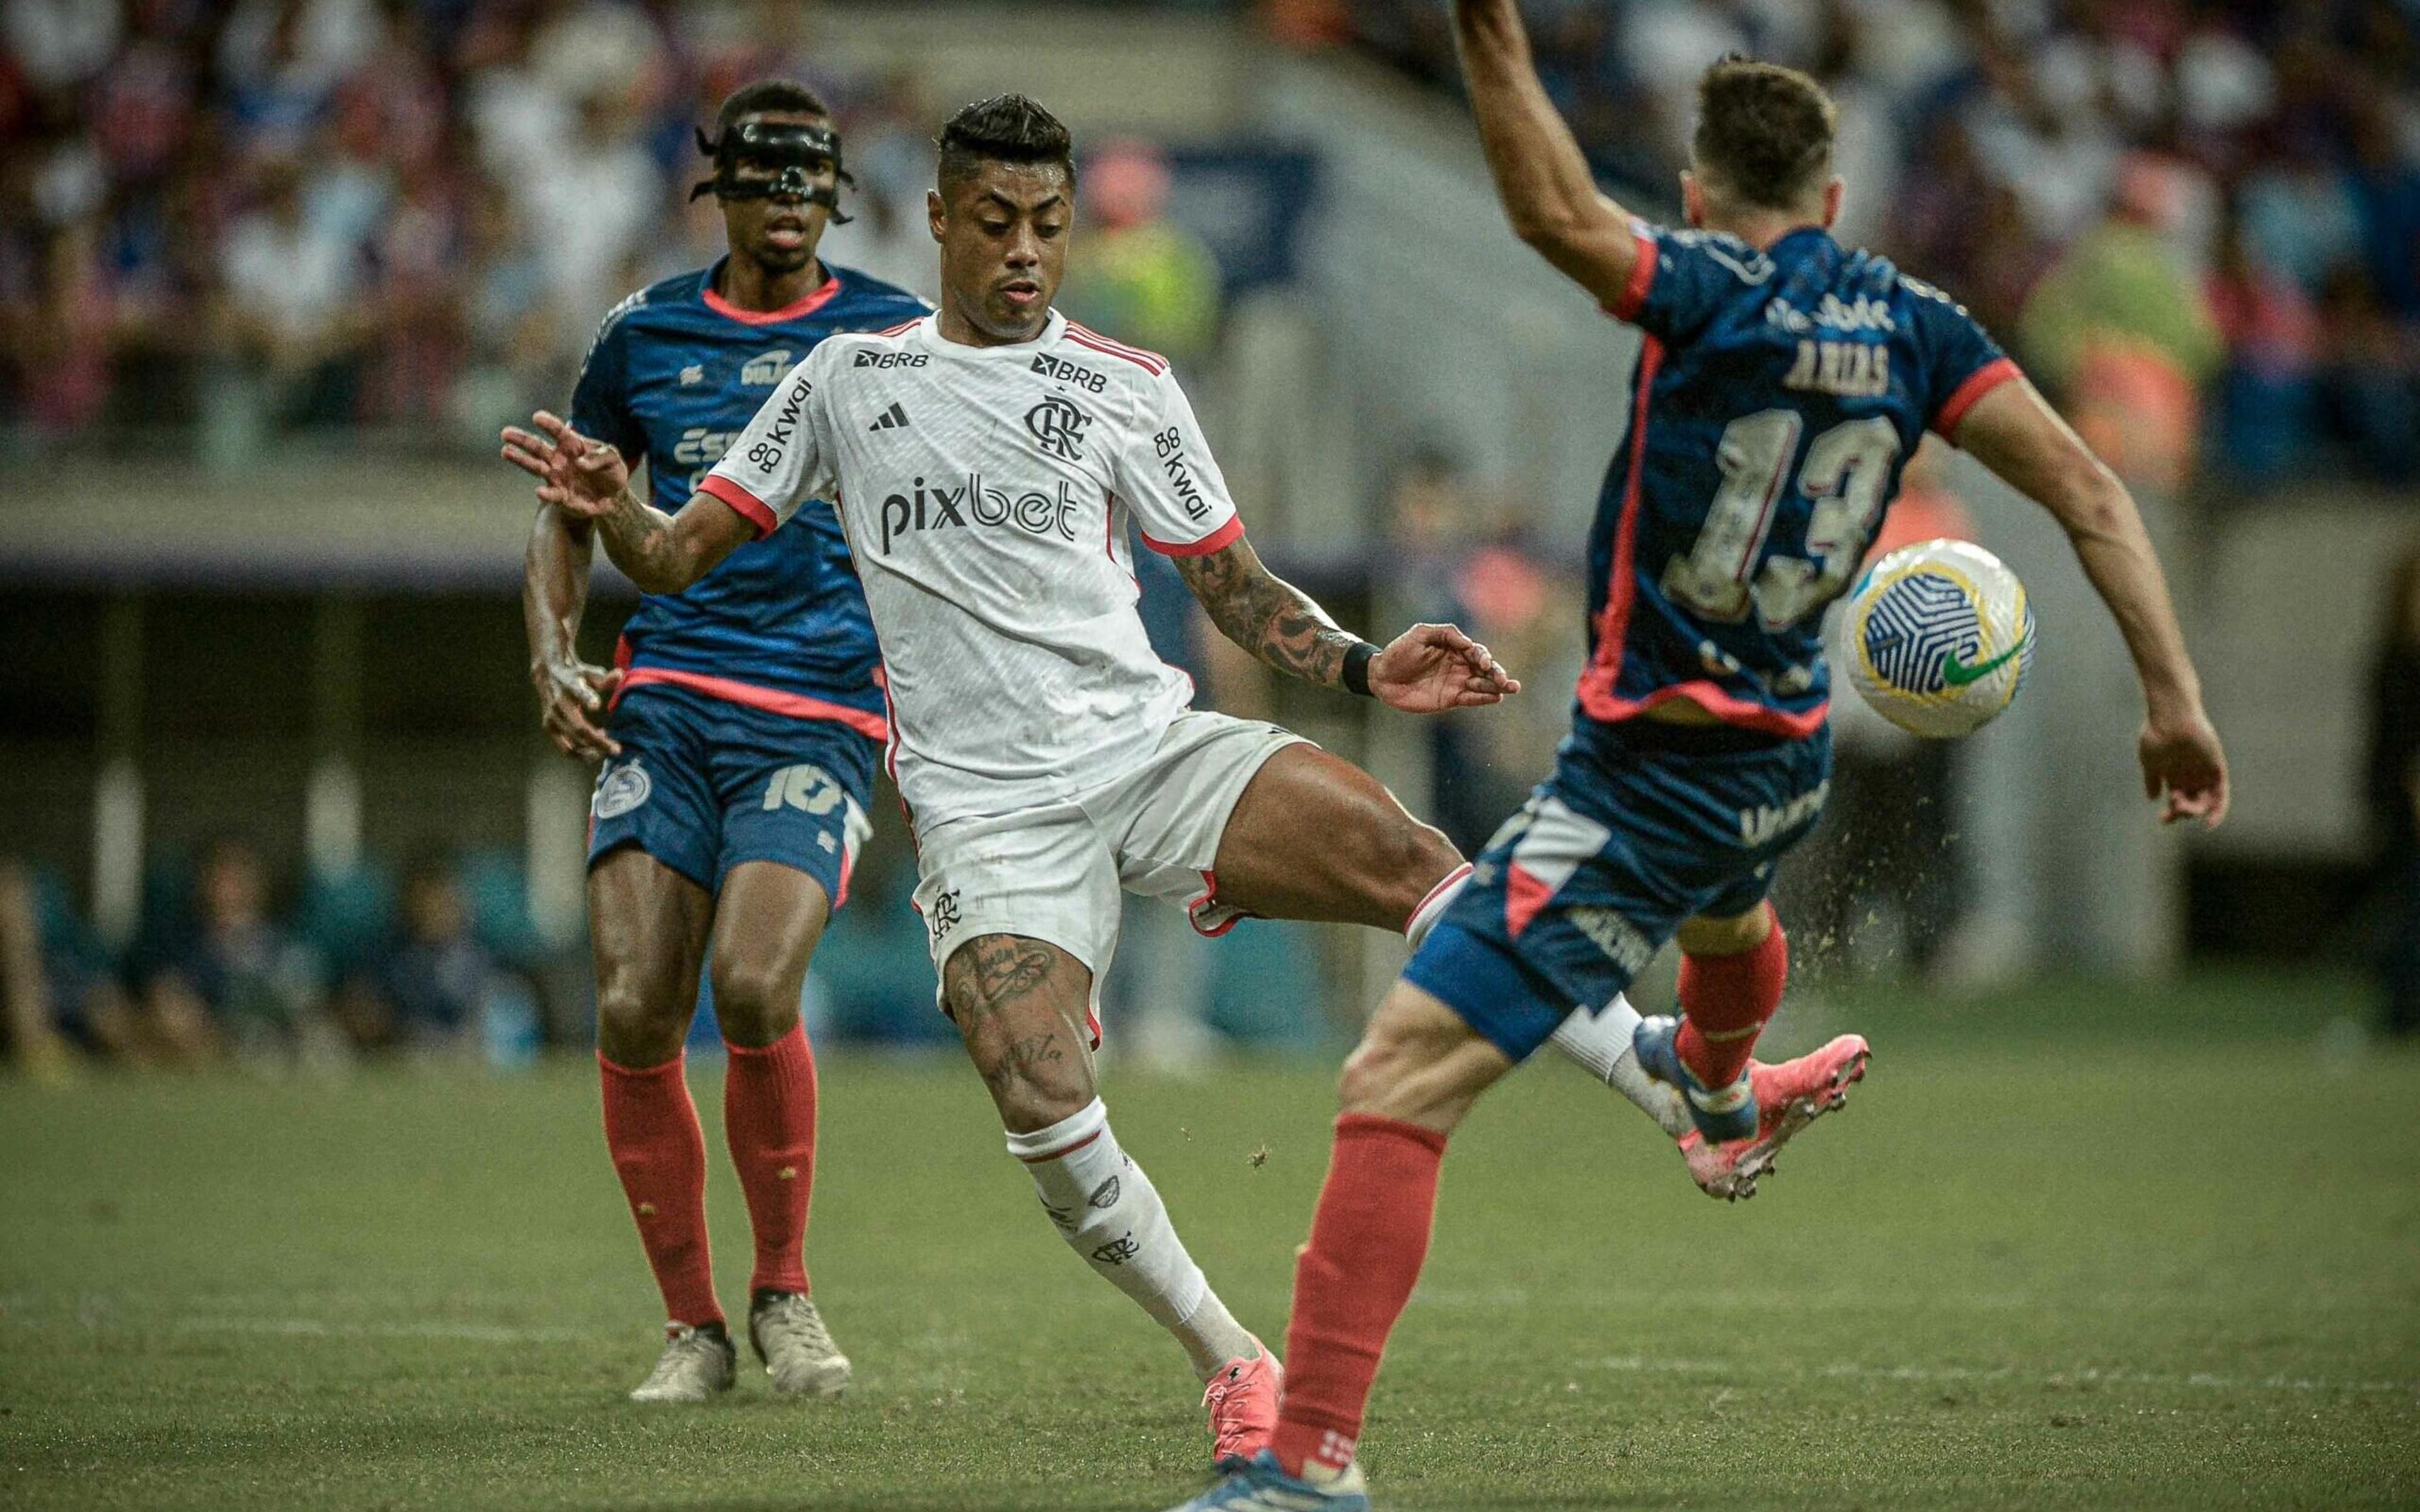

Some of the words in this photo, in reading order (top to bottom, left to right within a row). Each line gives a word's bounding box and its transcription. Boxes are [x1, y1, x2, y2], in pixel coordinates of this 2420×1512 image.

[877, 352, 929, 369] BRB
[1055, 360, 1107, 393] BRB
[766, 377, 812, 446] kwai
[882, 472, 1077, 556] pixbet
[1164, 451, 1213, 521] kwai
[1661, 408, 1900, 632] 13
[763, 764, 844, 816] 10
